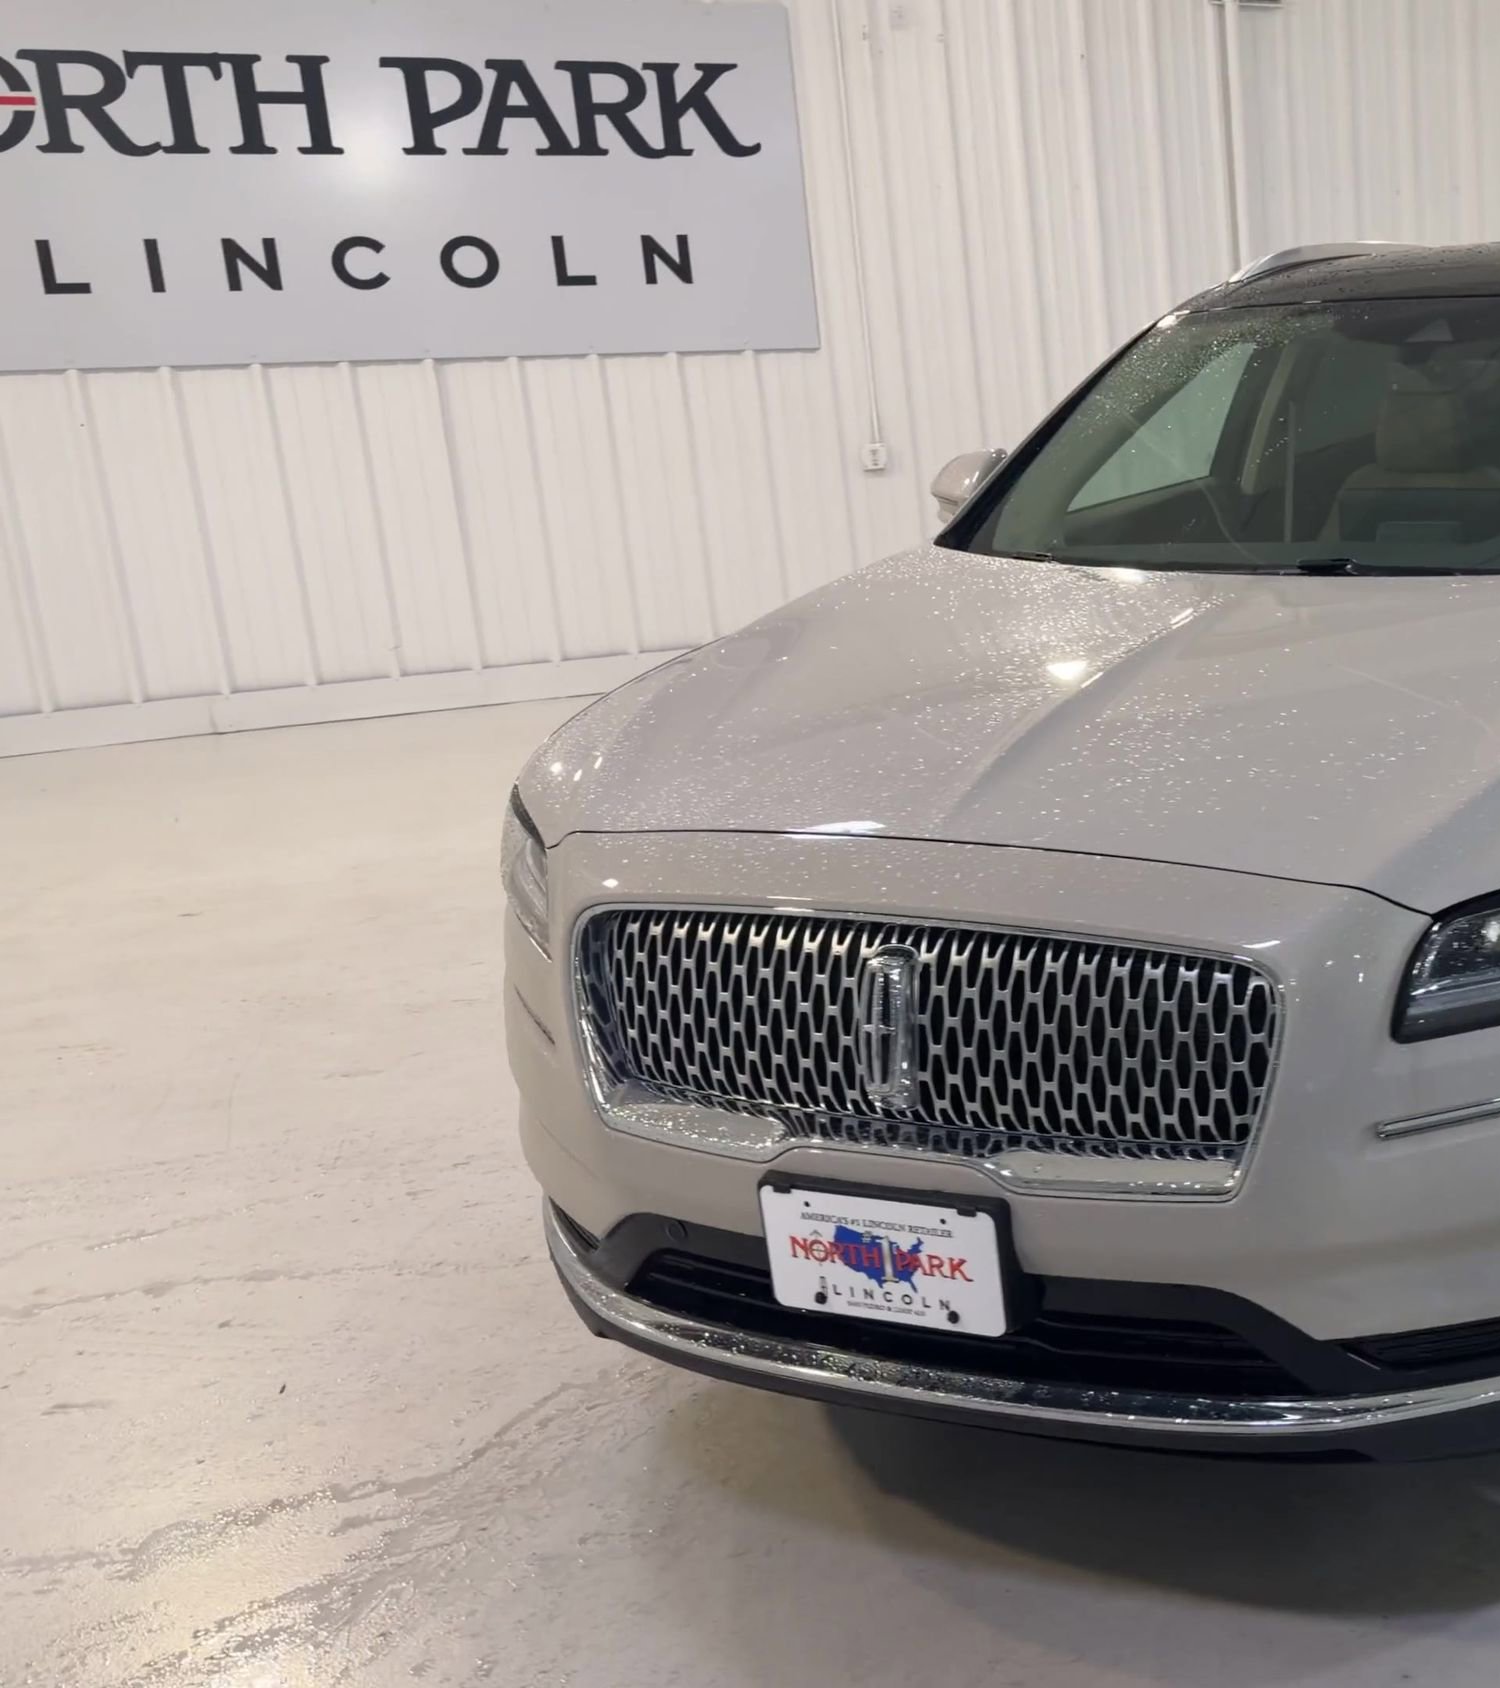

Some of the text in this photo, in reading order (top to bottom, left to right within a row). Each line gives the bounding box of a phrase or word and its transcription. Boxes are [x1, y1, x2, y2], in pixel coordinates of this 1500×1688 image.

[380, 57, 762, 159] PARK
[35, 235, 694, 294] LINCOLN
[863, 1219, 906, 1232] LINCOLN
[789, 1236, 974, 1282] NORTH PARK
[833, 1284, 950, 1311] LINCOLN
